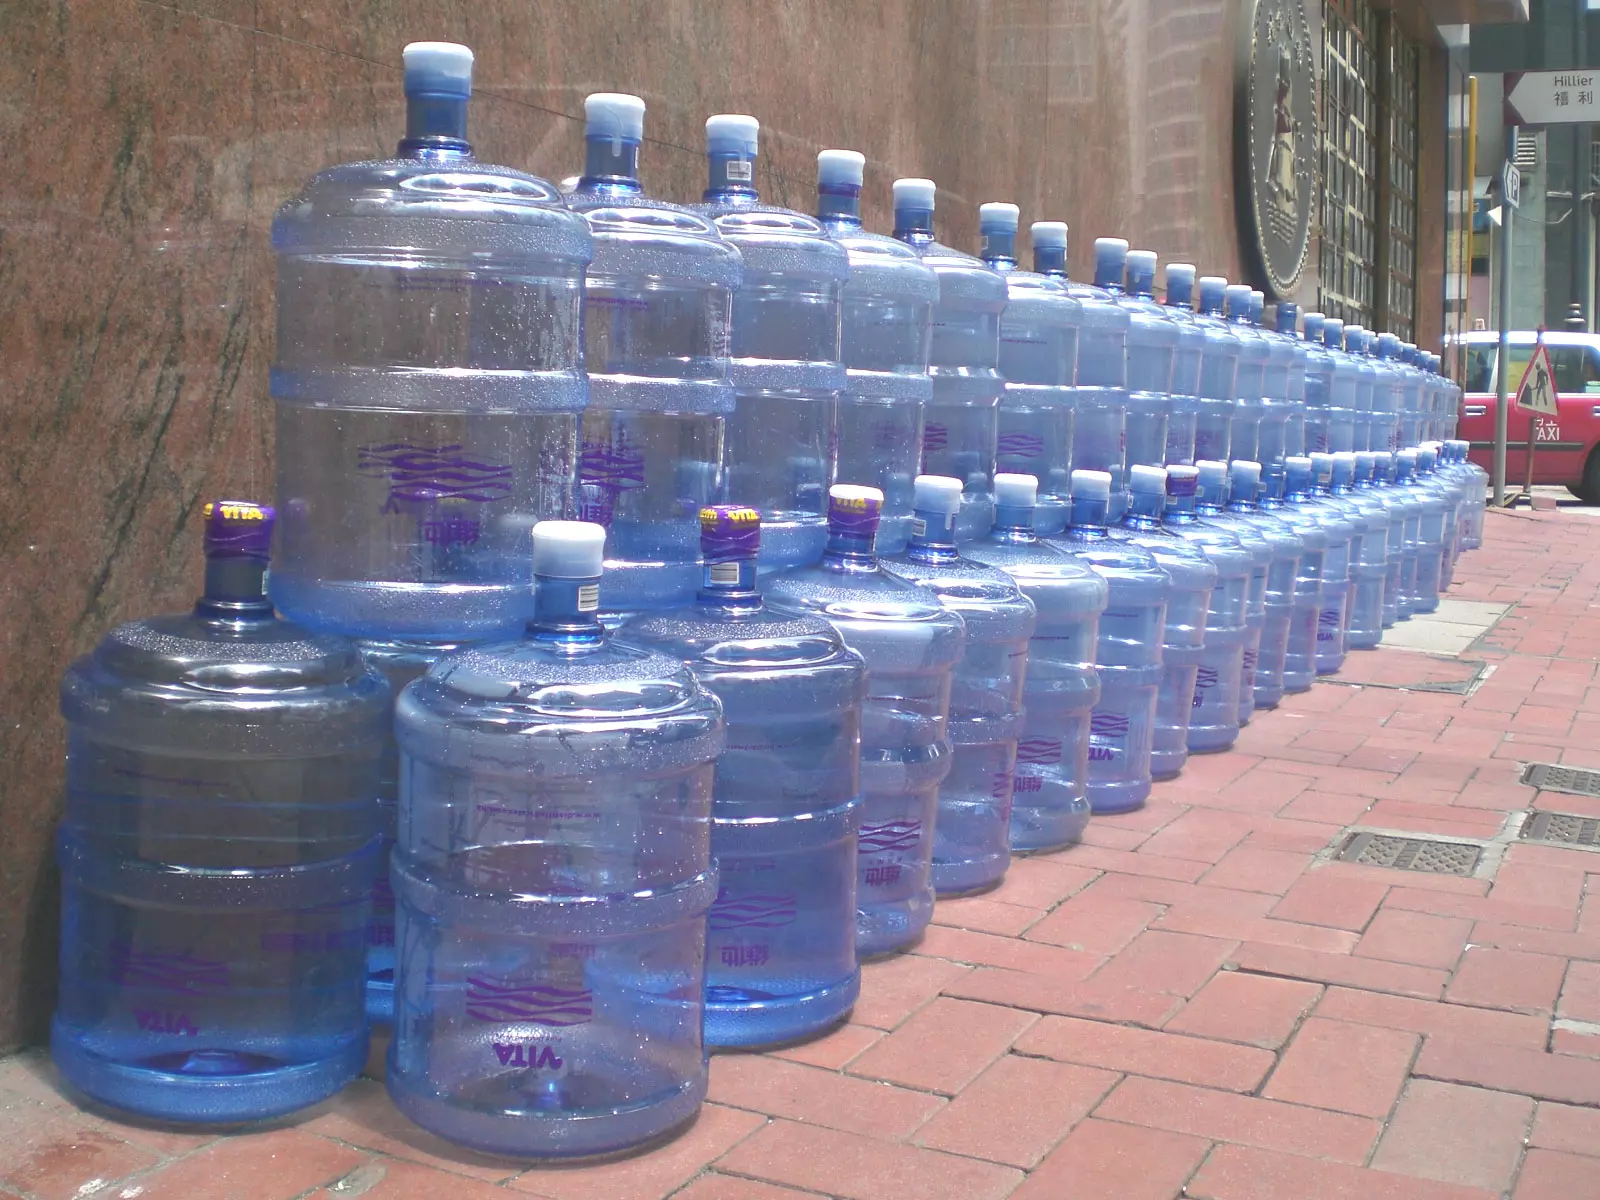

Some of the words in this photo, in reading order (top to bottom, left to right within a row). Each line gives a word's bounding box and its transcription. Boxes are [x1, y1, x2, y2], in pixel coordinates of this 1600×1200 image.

[1554, 75, 1594, 87] Hillier
[1535, 427, 1560, 441] AXI
[492, 1041, 564, 1070] VITA
